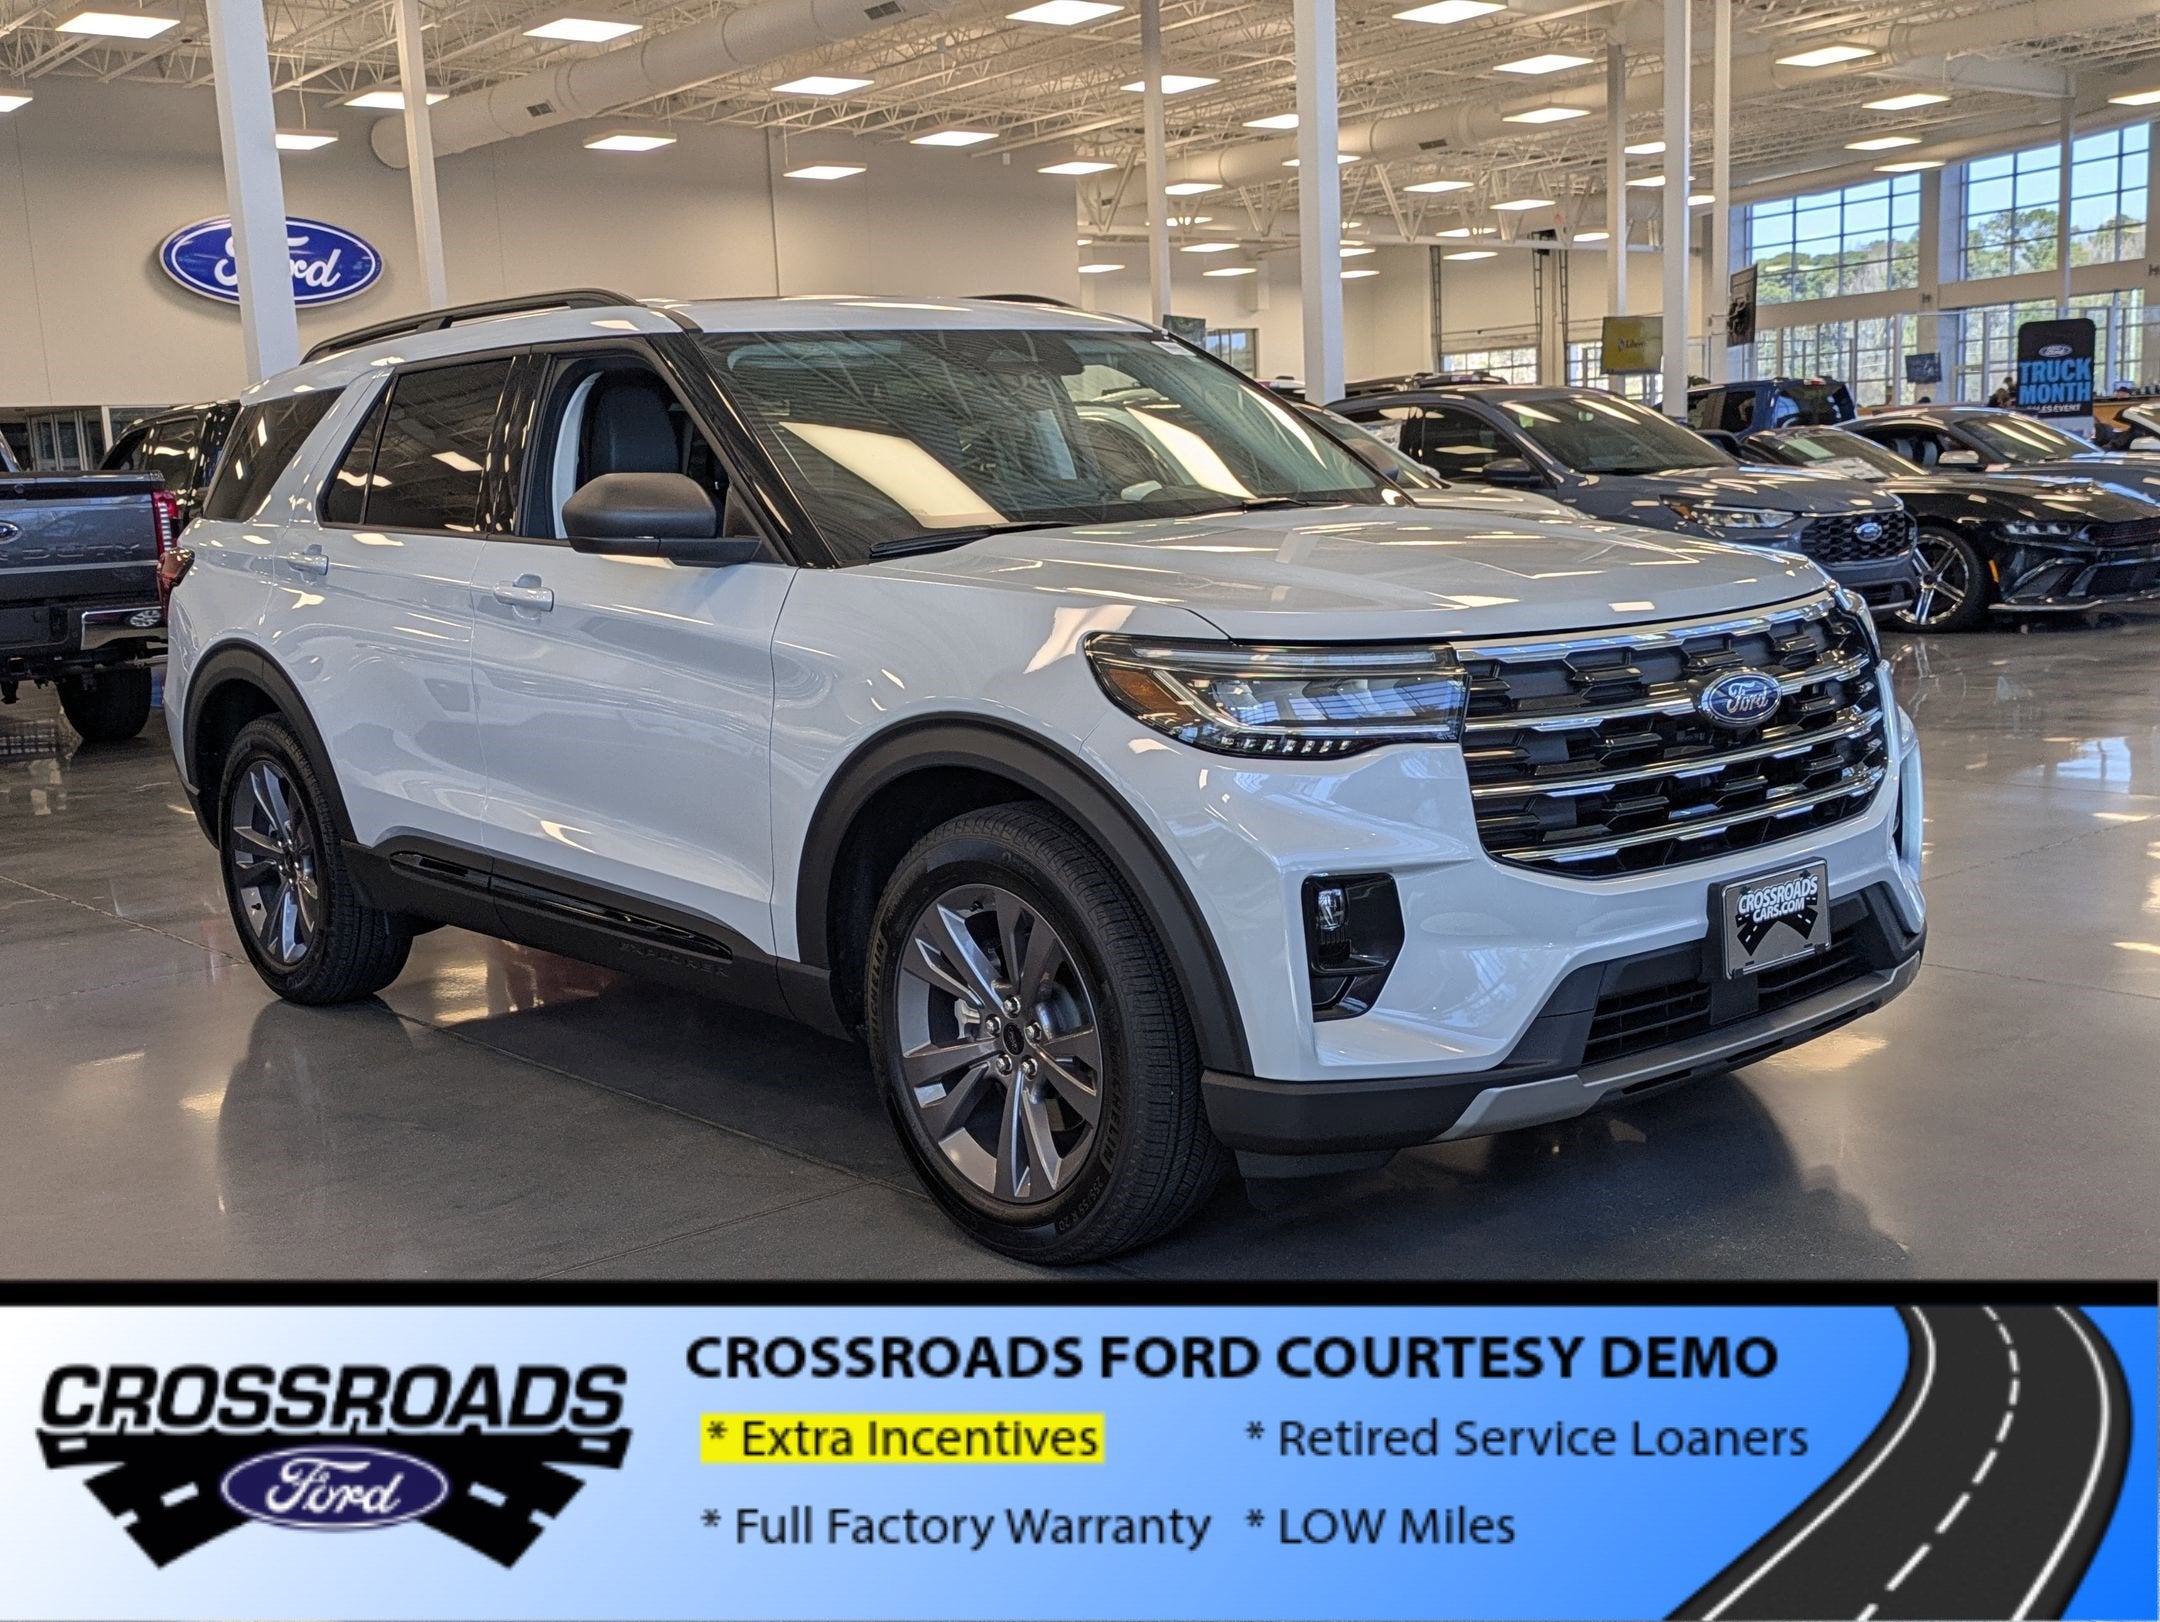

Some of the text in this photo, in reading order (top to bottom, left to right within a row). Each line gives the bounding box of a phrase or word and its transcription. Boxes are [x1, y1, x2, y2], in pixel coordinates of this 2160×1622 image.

[214, 235, 341, 287] Frd
[2019, 358, 2091, 384] TRUCK
[2019, 381, 2091, 404] MONTH
[1726, 680, 1769, 714] Ford
[1738, 874, 1818, 915] CROSSROADS
[1752, 897, 1805, 924] CARS.COM
